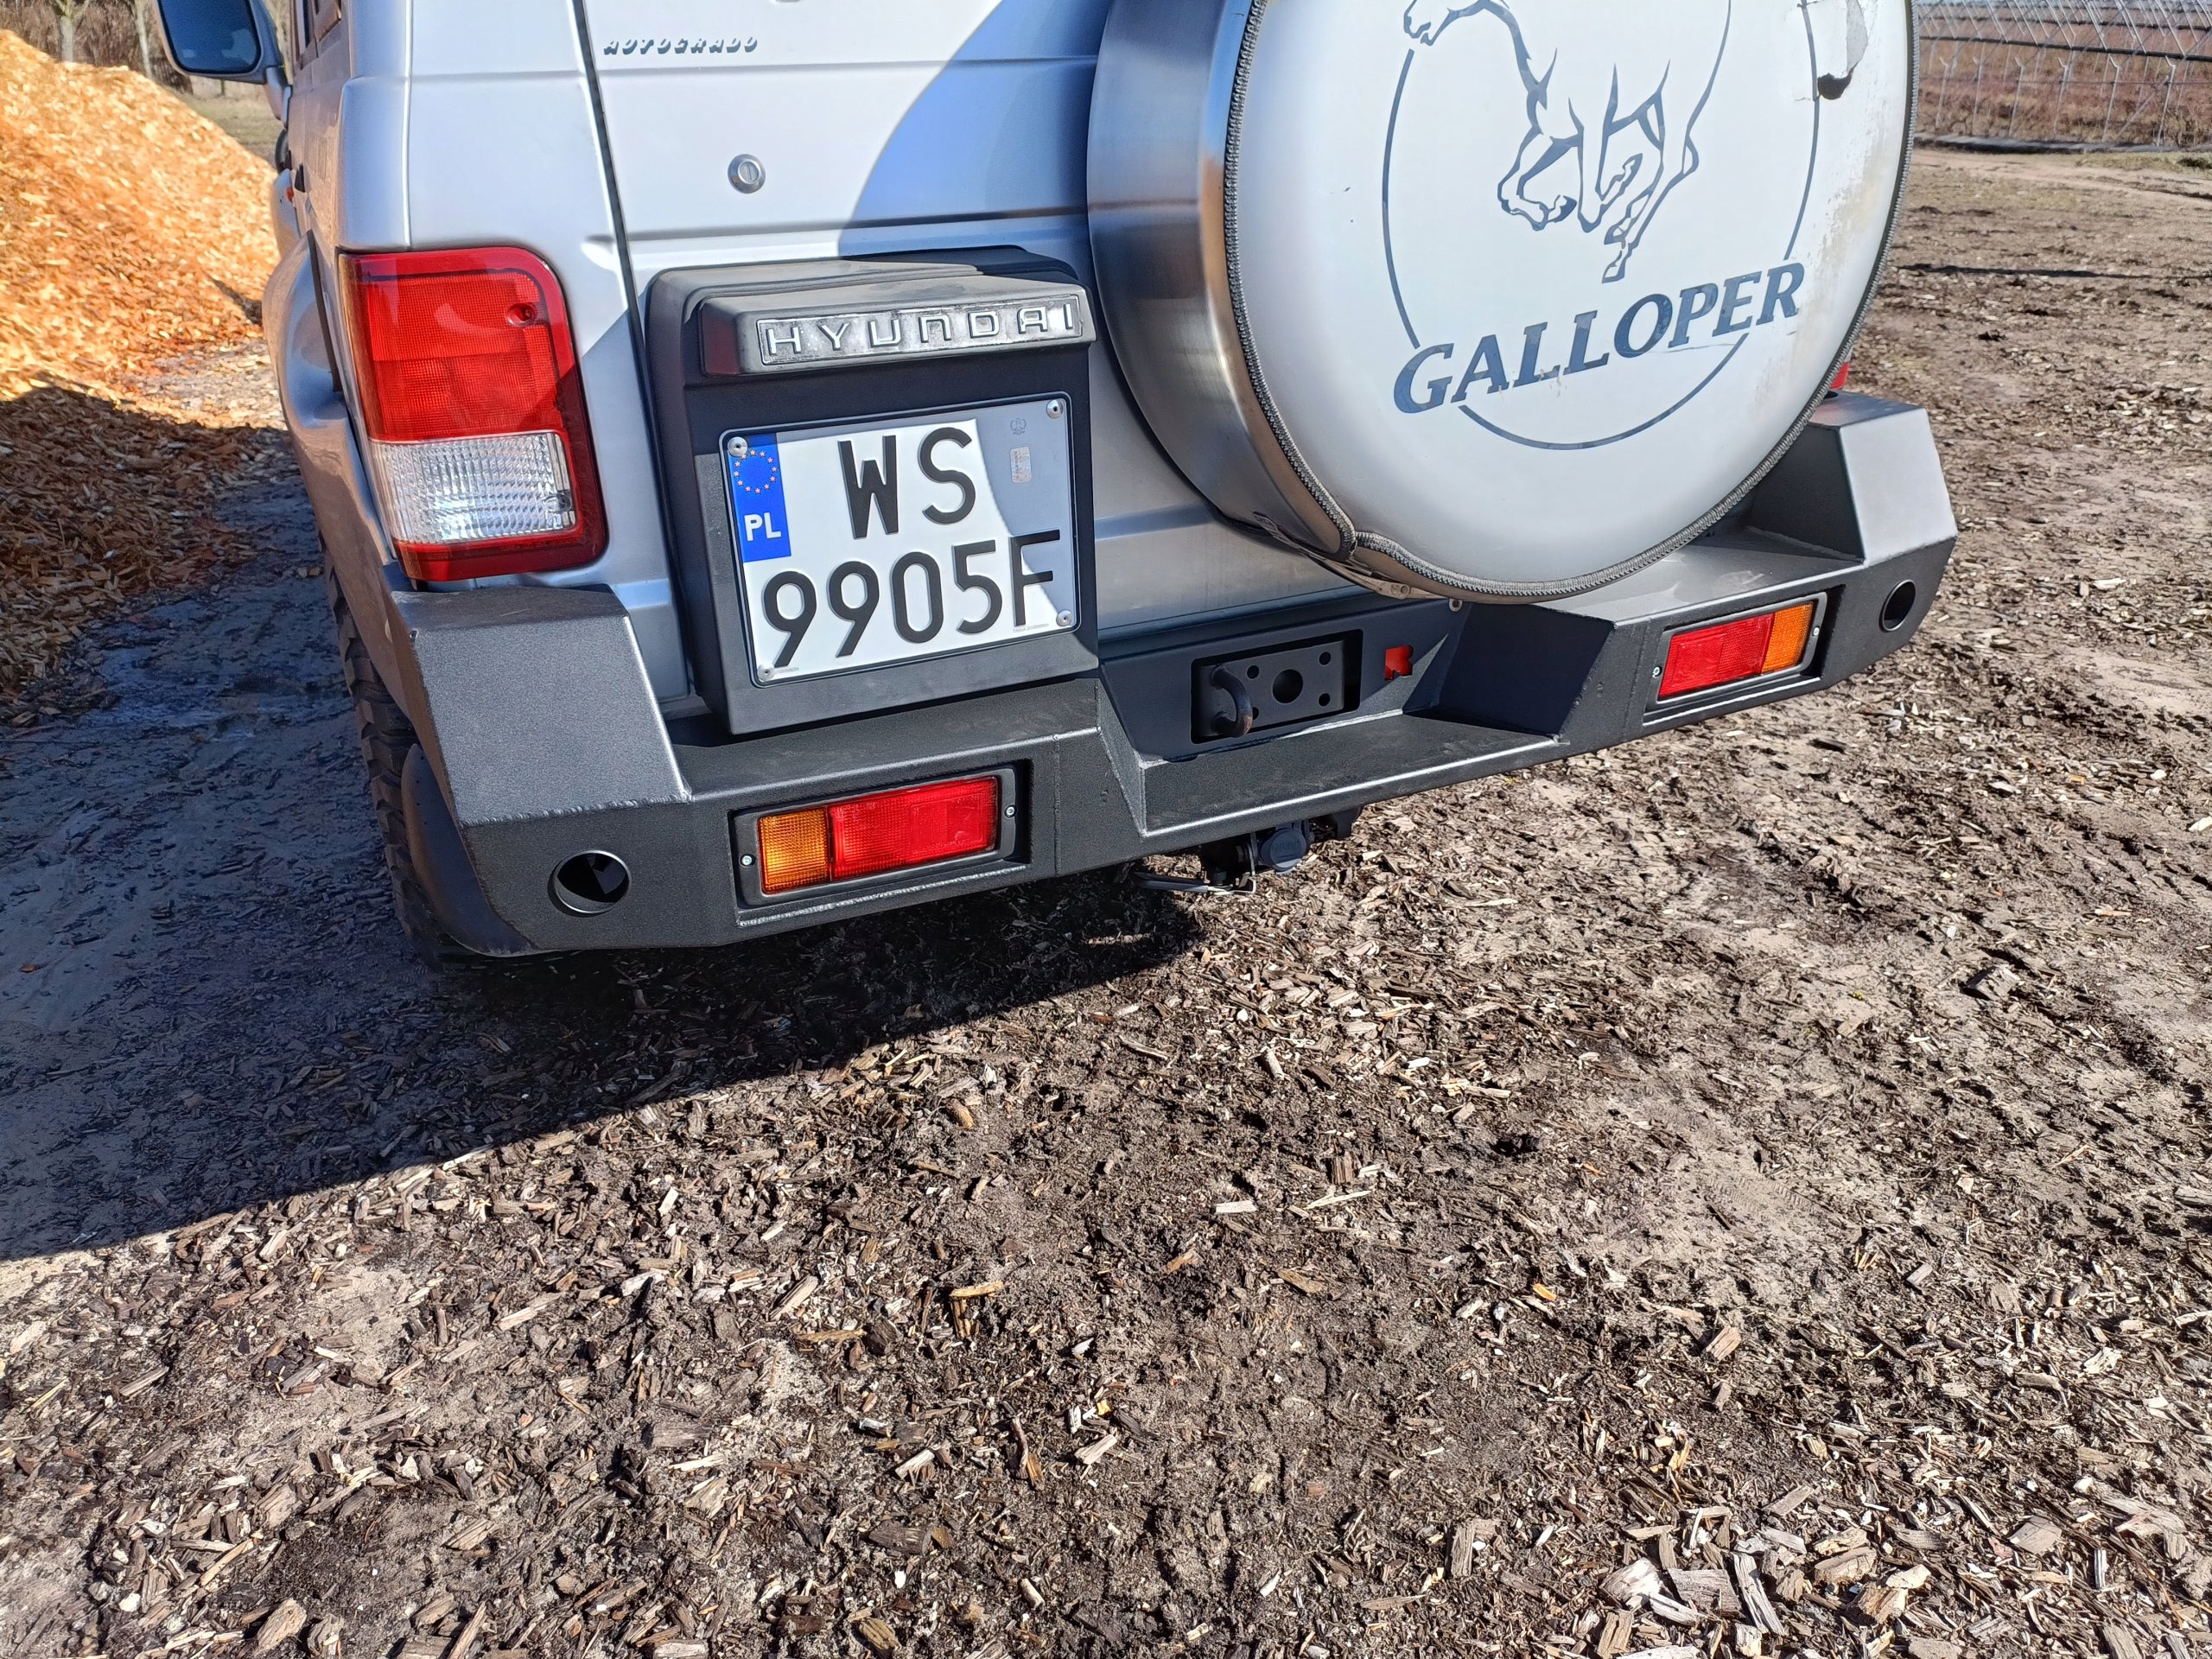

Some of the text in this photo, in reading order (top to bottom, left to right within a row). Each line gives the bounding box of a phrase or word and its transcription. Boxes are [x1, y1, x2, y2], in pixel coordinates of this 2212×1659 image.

[767, 304, 1073, 355] HYUNDAI
[1394, 262, 1805, 414] GALLOPER
[744, 513, 782, 542] PL
[837, 427, 976, 540] WS
[762, 529, 1060, 668] 9905F
